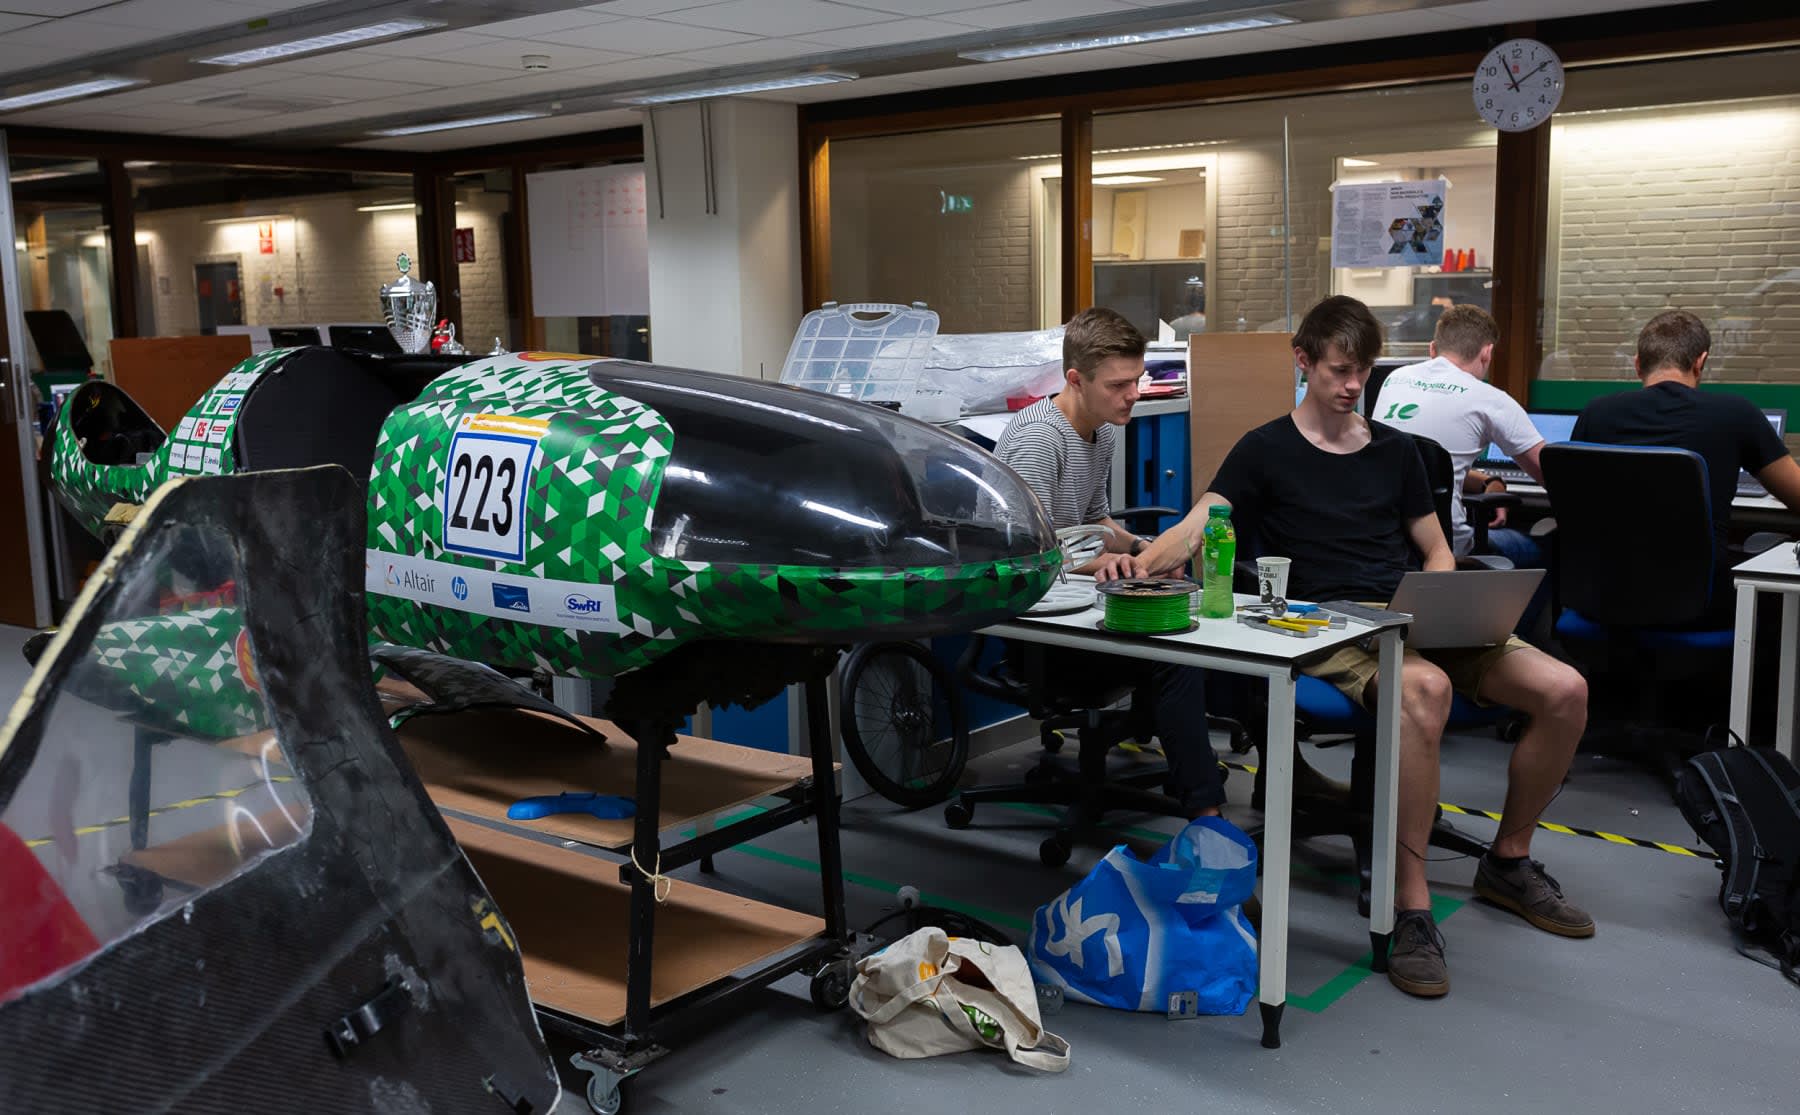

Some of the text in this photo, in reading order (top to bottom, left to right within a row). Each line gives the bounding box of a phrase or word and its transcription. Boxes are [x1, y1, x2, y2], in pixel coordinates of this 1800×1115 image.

[1512, 48, 1522, 59] 12
[1486, 66, 1497, 77] 10
[1543, 77, 1551, 88] 3
[1481, 83, 1489, 93] 9
[1485, 99, 1493, 109] 8
[1538, 94, 1545, 104] 4
[1496, 109, 1504, 119] 7
[1511, 112, 1519, 122] 6
[1527, 107, 1534, 117] 5
[450, 453, 516, 537] 223
[404, 570, 436, 593] Altair
[453, 577, 467, 600] hp
[567, 598, 601, 612] SwRI
